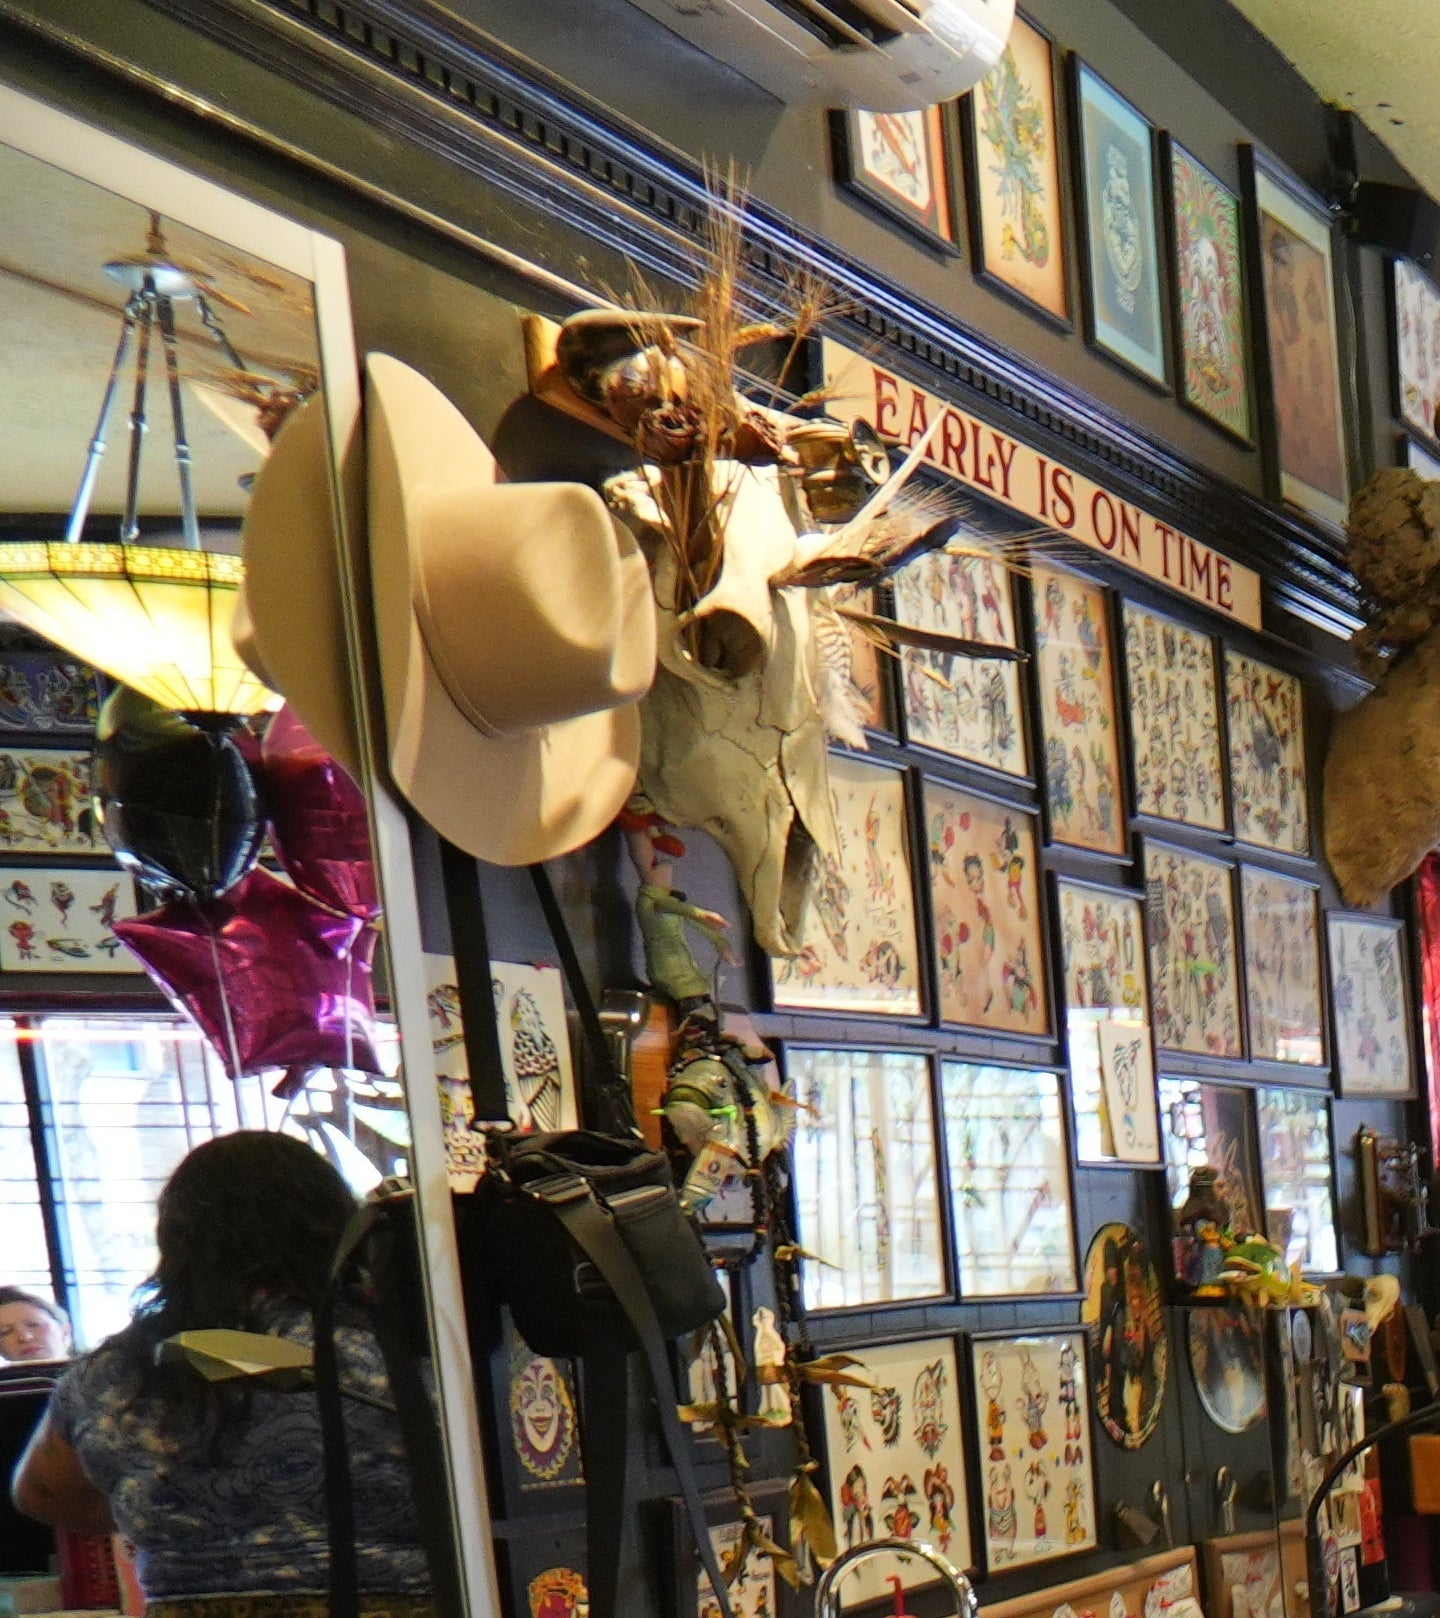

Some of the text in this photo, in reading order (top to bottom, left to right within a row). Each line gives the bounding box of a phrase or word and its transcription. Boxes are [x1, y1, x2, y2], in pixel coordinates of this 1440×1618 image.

[871, 366, 1235, 612] EARLY IS ON TIME
